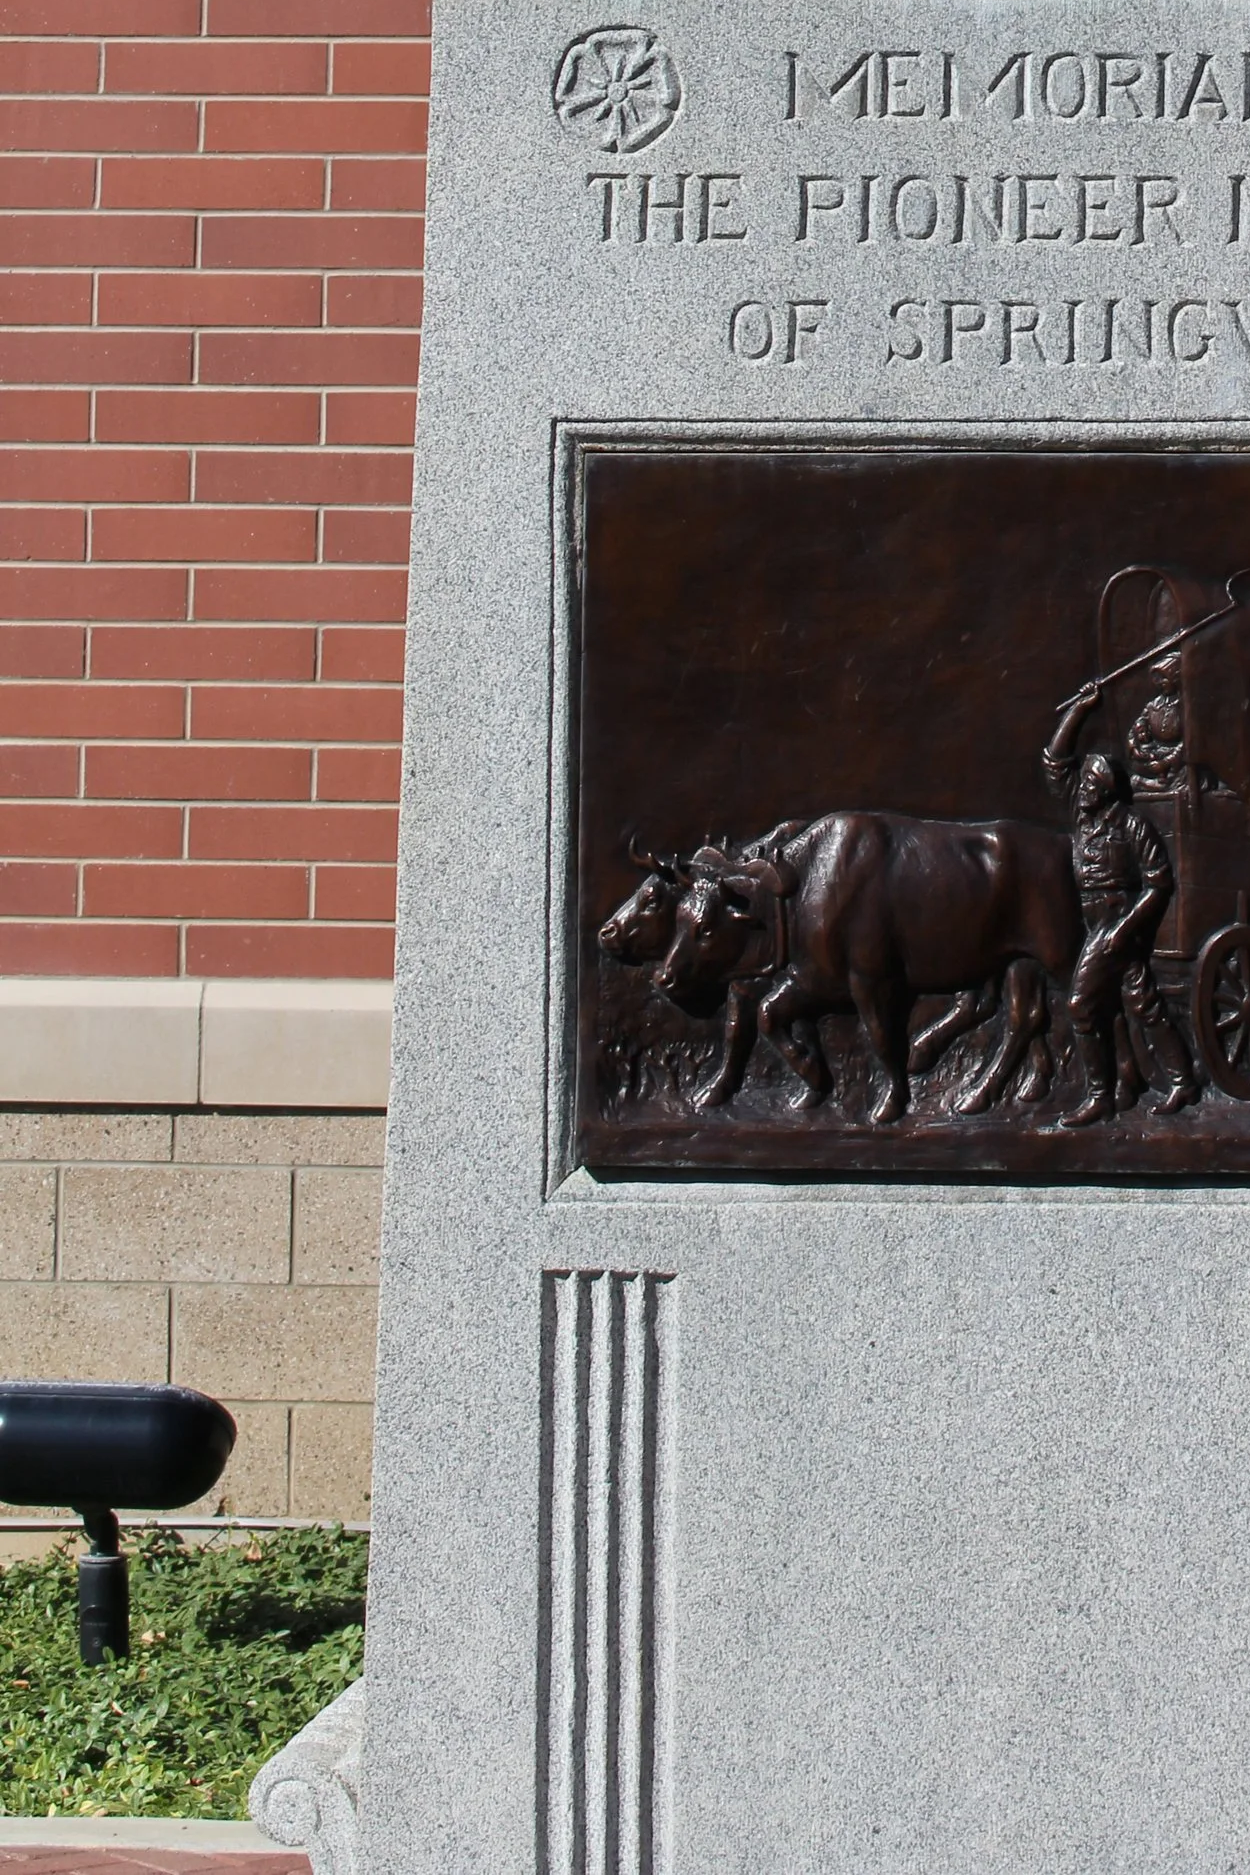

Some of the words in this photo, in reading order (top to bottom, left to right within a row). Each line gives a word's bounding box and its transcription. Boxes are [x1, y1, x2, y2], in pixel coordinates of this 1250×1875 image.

[586, 172, 748, 244] THE
[794, 173, 1186, 246] PIONEER
[728, 299, 832, 365] OF
